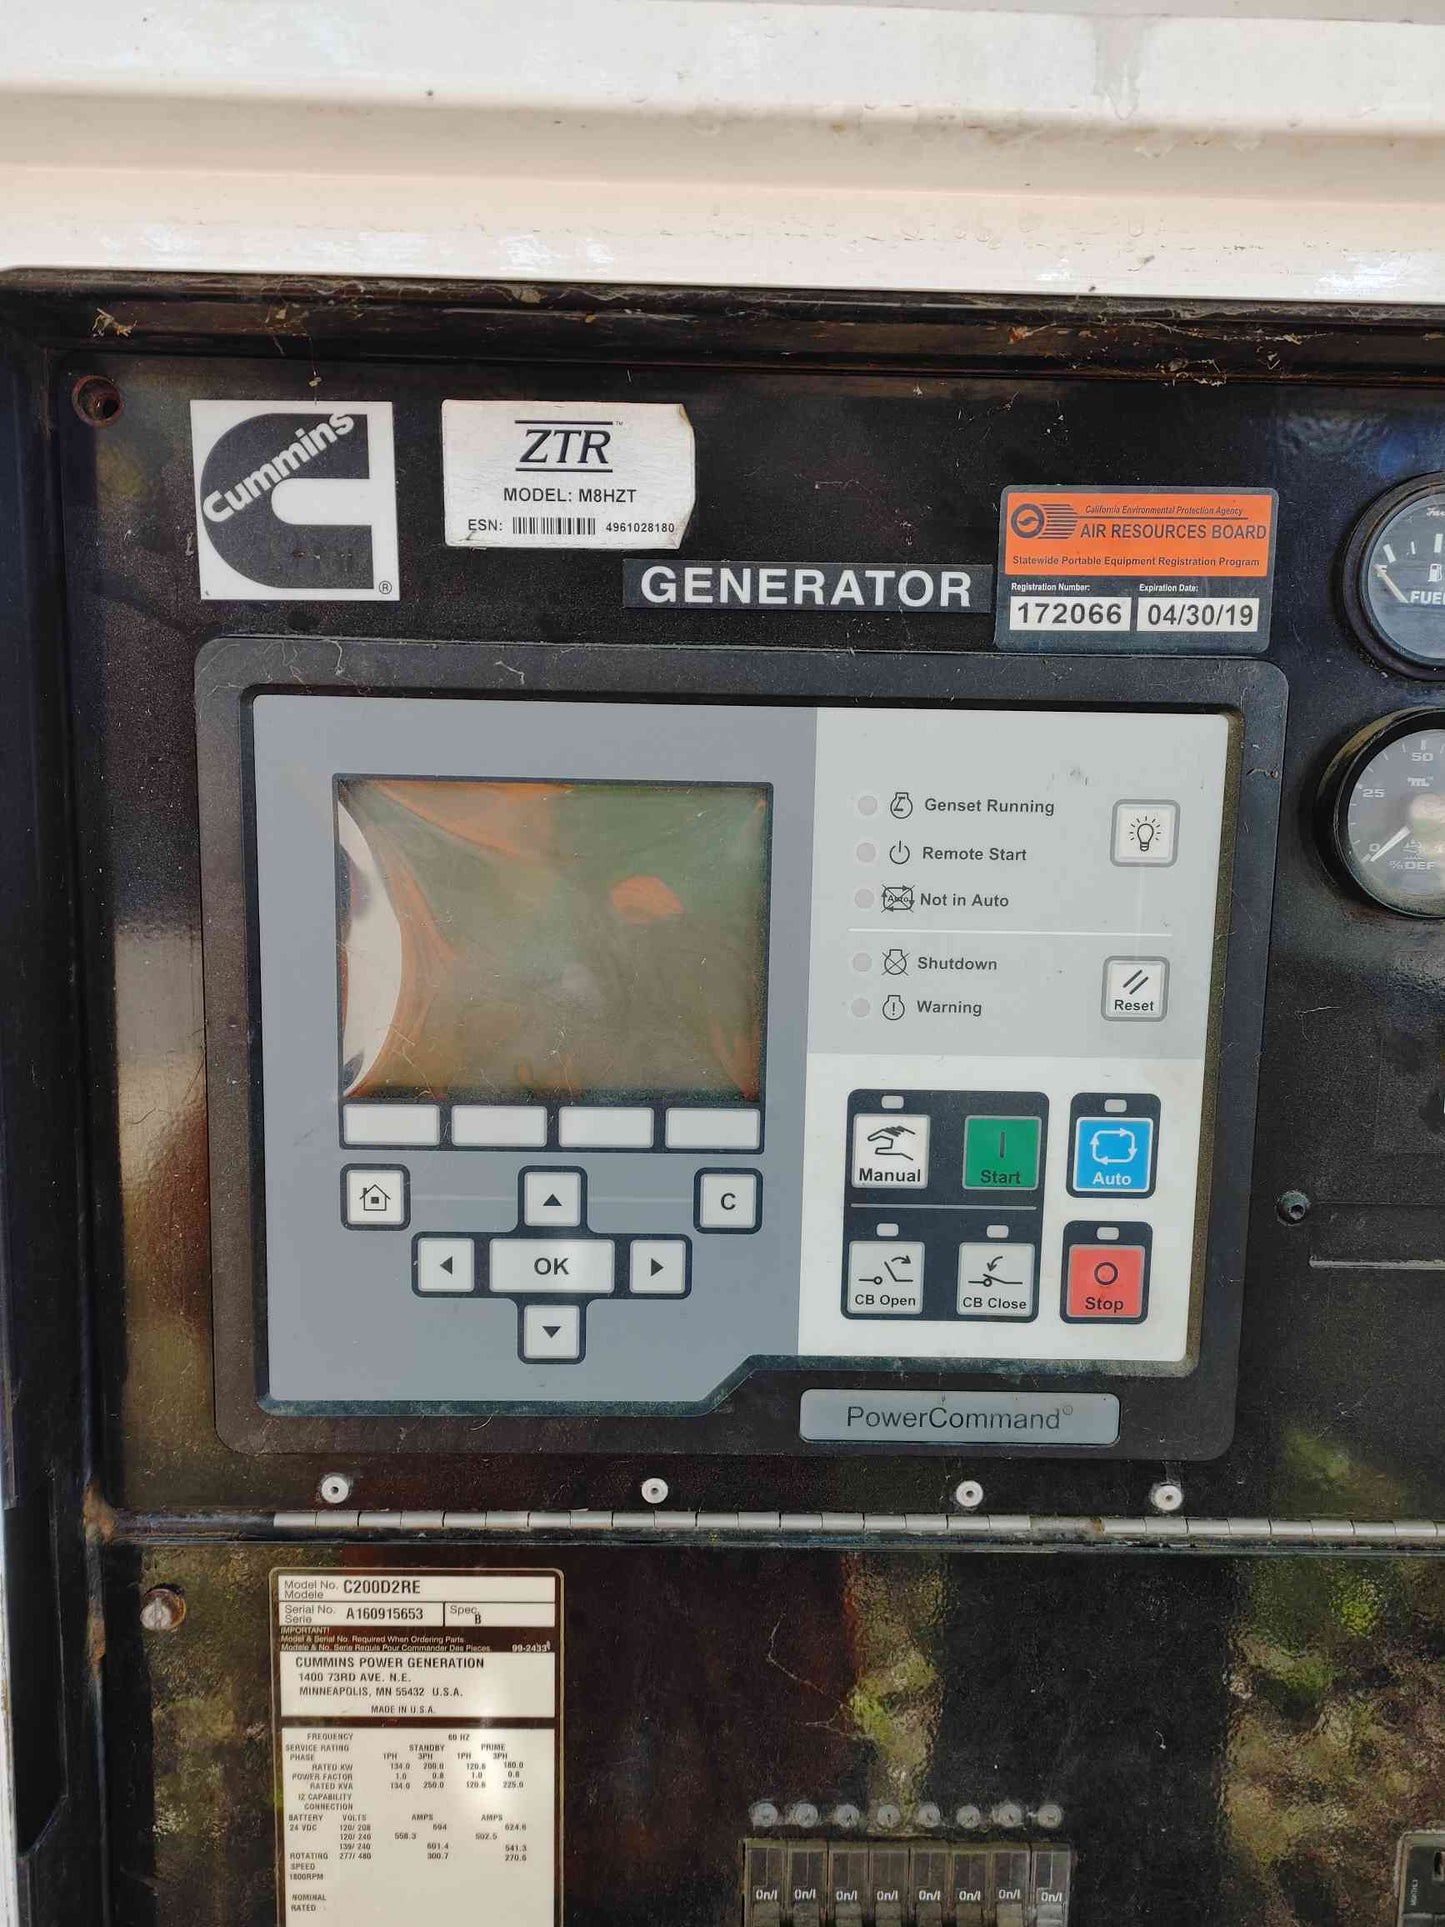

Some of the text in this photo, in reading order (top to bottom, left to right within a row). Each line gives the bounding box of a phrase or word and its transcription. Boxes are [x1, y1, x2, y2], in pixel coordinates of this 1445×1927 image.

[520, 429, 611, 463] ZTR
[202, 413, 354, 523] Cummins
[503, 487, 638, 504] MODEL: M8HZT
[1085, 505, 1244, 517] California Environmental Protection Agency
[468, 519, 675, 534] ESN: 4961028180
[1080, 523, 1267, 540] AIR RESOURCES BOARD
[1012, 555, 1260, 569] Statewide Portable Equipment Registration Program
[641, 565, 972, 607] GENERATOR
[1011, 582, 1091, 593] Registration Number:
[1139, 583, 1199, 594] Expiration Date:
[1410, 590, 1445, 605] FUE
[1017, 602, 1122, 624] 172066
[1147, 604, 1254, 626] 04/30/19
[1411, 752, 1434, 762] 50
[1362, 788, 1385, 798] 25
[924, 798, 1055, 817] Genset Running
[922, 846, 1027, 861] Remote Start
[920, 893, 1009, 908] Not in Auto
[917, 957, 998, 971] Shutdown
[916, 1000, 982, 1018] Warning
[1114, 999, 1155, 1012] Reset
[858, 1168, 921, 1183] Manual
[980, 1169, 1021, 1185] Start
[1092, 1171, 1132, 1186] Auto
[720, 1192, 736, 1212] C
[533, 1257, 570, 1277] OK
[855, 1293, 916, 1309] CB Open
[962, 1296, 1027, 1310] CB Close
[1084, 1297, 1124, 1313] Stop
[846, 1406, 1061, 1430] PowerCommand
[284, 1579, 421, 1594] Model No. C200D2RE
[284, 1604, 424, 1620] Serial No. A160915653
[474, 1614, 482, 1625] B
[280, 1626, 330, 1635] IMPORTANT!
[281, 1635, 305, 1643] Model
[314, 1635, 335, 1643] Serial
[352, 1635, 386, 1644] Required
[387, 1635, 409, 1643] When
[410, 1635, 444, 1645] Ordering
[445, 1635, 464, 1643] Parts
[382, 1644, 400, 1652] Pour
[401, 1644, 448, 1652] Commander
[295, 1656, 485, 1669] CUMMINS POWER GENERATION
[299, 1673, 412, 1682] 1400 73RD AVE. N.E.
[299, 1686, 463, 1698] MINNEAPOLIS, MN 55432 U.S.A.
[371, 1705, 395, 1714] MADE
[399, 1705, 408, 1714] IN
[306, 1732, 354, 1741] FREQUENCY
[448, 1733, 470, 1741] 60 HZ
[285, 1744, 349, 1752] SERVICE RATING
[409, 1744, 445, 1752] STANDBY
[480, 1743, 506, 1752] PRIME
[289, 1753, 315, 1761] PHASE
[383, 1752, 398, 1760] 1PH
[417, 1752, 433, 1760] 3PH
[457, 1752, 472, 1760] 1PH
[492, 1752, 508, 1760] 3PH
[312, 1763, 354, 1771] RATED KW
[291, 1773, 353, 1781] POWER FACTOR
[395, 1772, 407, 1780] 1.0
[309, 1782, 354, 1790] RATED KVA
[390, 1782, 410, 1790] 134.0
[423, 1781, 444, 1789] 250.0
[307, 1793, 352, 1801] CAPABILITY
[304, 1803, 354, 1811] CONNECTION
[411, 1813, 434, 1821] AMPS
[358, 1833, 372, 1841] 240
[289, 1852, 329, 1860] ROTATING
[289, 1873, 324, 1881] 1800RPM
[291, 1893, 327, 1901] NOMINAL
